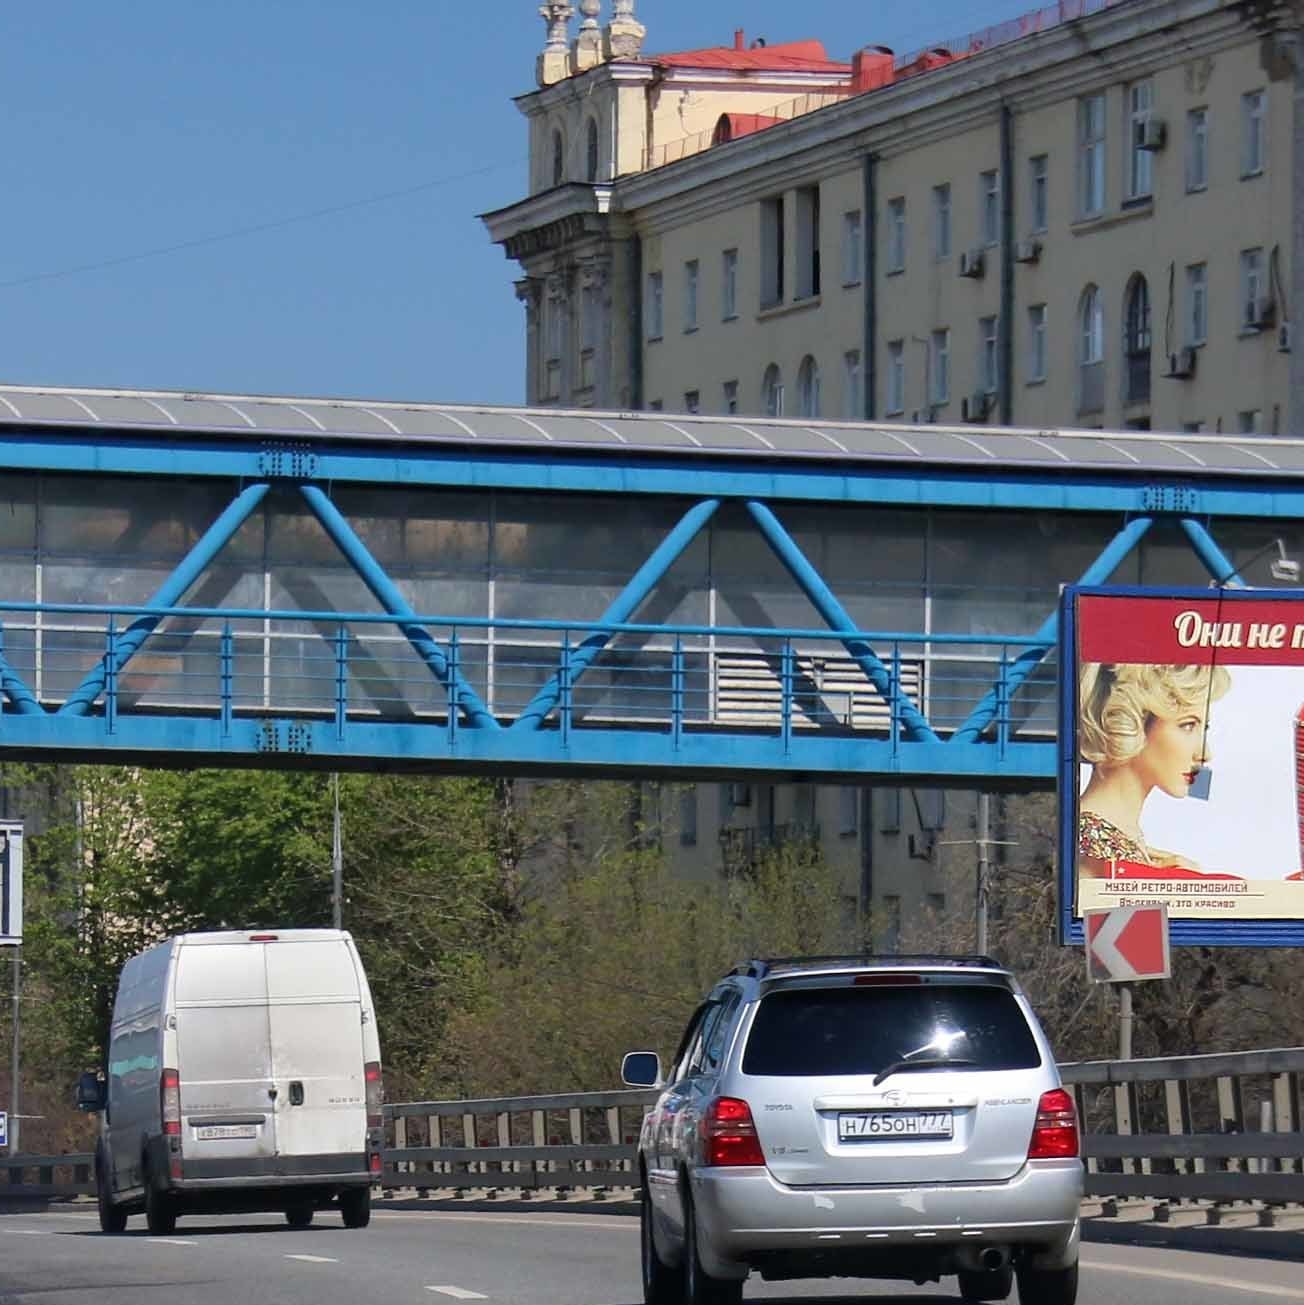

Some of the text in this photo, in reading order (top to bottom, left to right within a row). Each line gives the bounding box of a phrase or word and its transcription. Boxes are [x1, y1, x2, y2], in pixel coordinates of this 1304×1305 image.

[1174, 610, 1241, 648] Они
[1246, 622, 1286, 650] не
[1105, 881, 1248, 893] МУЗЕЙ РЕТРО-АВТОМОБИЛЕЙ
[921, 1112, 947, 1127] 777
